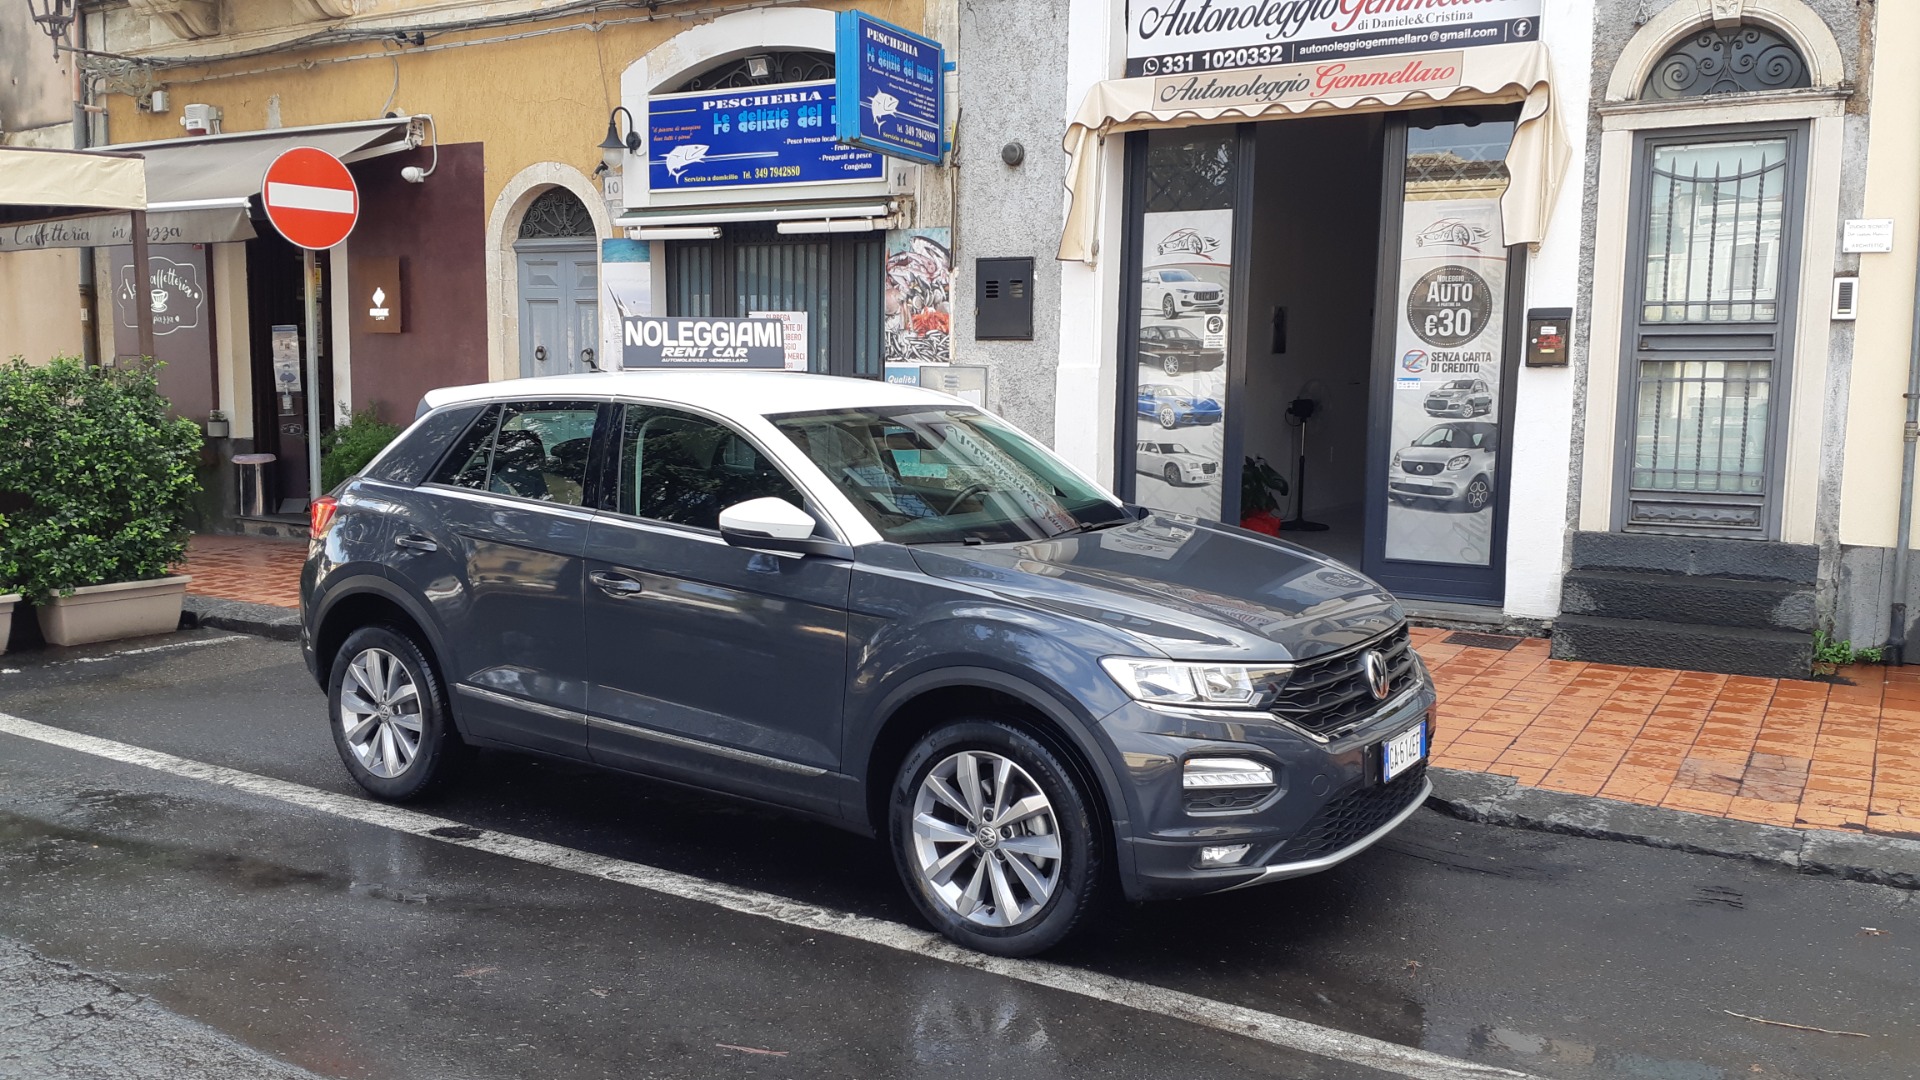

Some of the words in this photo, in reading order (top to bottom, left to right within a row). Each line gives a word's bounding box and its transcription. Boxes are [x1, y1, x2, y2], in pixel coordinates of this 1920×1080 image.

[1139, 0, 1338, 40] Autonoleggio
[1358, 19, 1368, 30] di
[1372, 10, 1473, 29] Daniele&Cristina
[866, 27, 918, 57] PESCHERIA
[1162, 54, 1194, 73] 331
[1202, 45, 1283, 69] 1020332
[1160, 73, 1310, 102] Autonoleggio
[1309, 60, 1455, 97] Gemmellaro
[703, 91, 822, 110] PESCHERIA
[905, 124, 914, 136] 349
[743, 170, 752, 179] Tel.
[754, 167, 768, 179] 349
[770, 165, 800, 178] 7942880
[844, 163, 872, 171] Congelato
[712, 173, 738, 181] domicilio
[897, 172, 907, 186] 11
[608, 182, 619, 194] 10
[14, 223, 91, 246] Caffetteria
[150, 267, 193, 298] affetteria
[1426, 281, 1473, 302] AUTO
[1424, 308, 1472, 337] €30
[625, 320, 782, 348] NOLEGGIAMI
[661, 347, 709, 357] RENT
[712, 347, 748, 357] CAR
[1431, 352, 1460, 362] SENZA
[1462, 352, 1492, 363] CARTA
[1431, 363, 1439, 373] DI
[1442, 363, 1480, 373] CREDITO
[888, 374, 917, 384] Qualità
